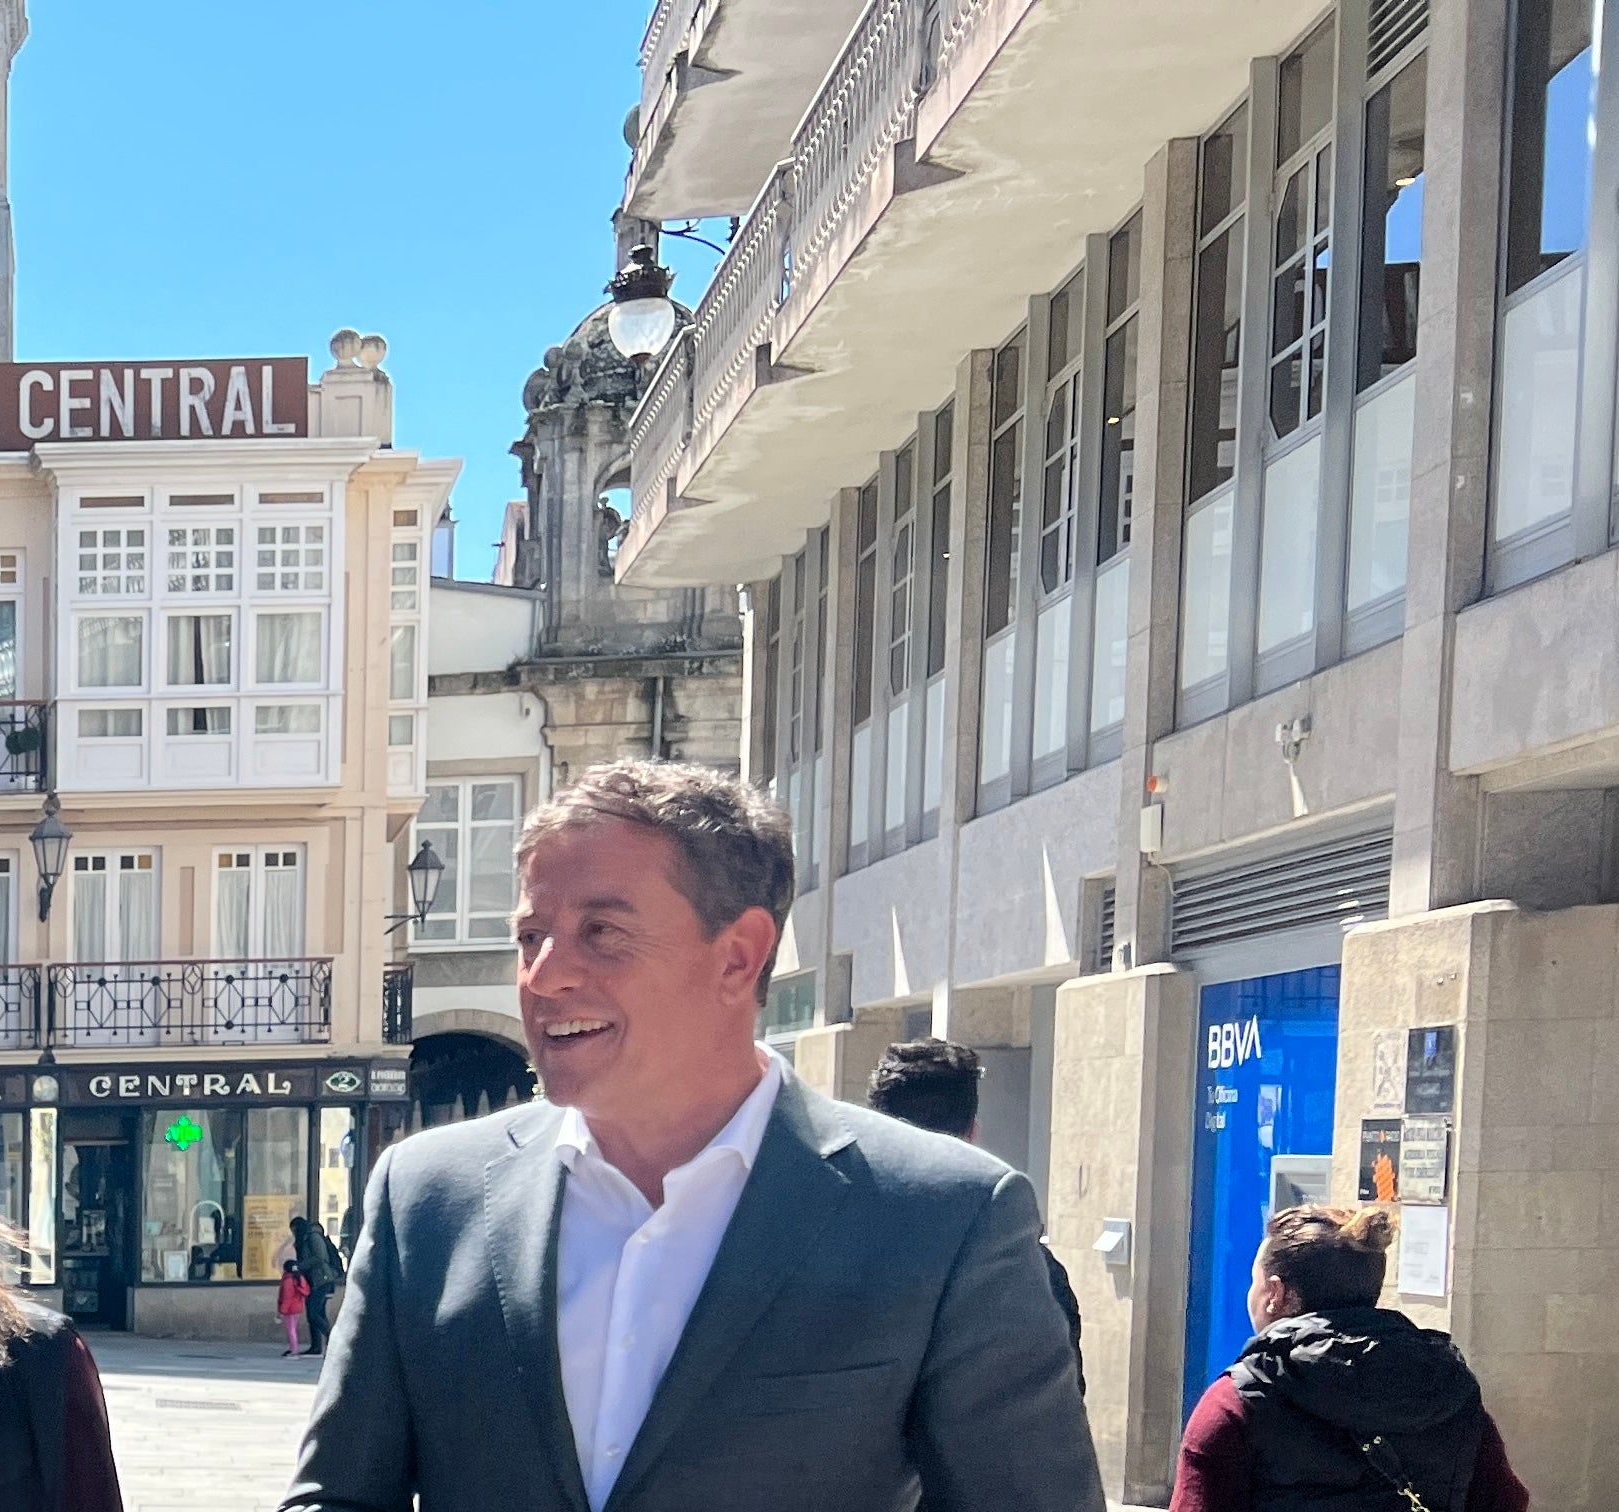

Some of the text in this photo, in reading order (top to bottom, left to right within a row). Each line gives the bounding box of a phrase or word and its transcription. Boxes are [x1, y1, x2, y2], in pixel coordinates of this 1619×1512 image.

[18, 364, 297, 440] CENTRAL
[1207, 1013, 1262, 1069] BBVA
[88, 1072, 292, 1098] CENTRAL
